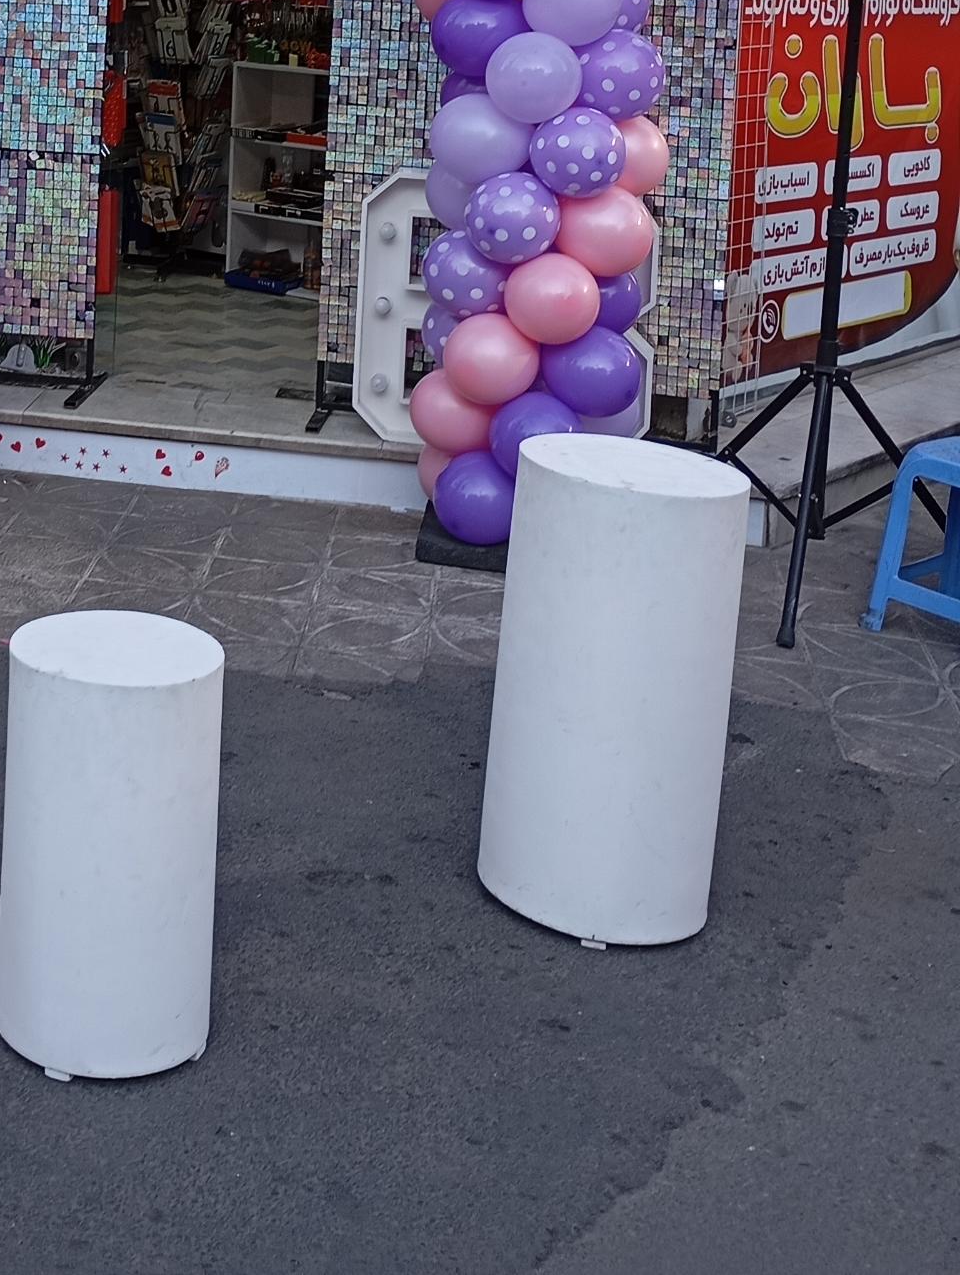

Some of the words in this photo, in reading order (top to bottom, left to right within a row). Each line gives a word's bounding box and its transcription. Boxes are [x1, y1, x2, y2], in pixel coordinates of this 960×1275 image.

[904, 155, 930, 178] کادویی
[780, 171, 810, 194] اسباب
[858, 207, 874, 227] عطر
[900, 200, 930, 219] عروسک
[764, 222, 786, 243] تولد
[786, 221, 798, 241] تم
[855, 247, 882, 268] مصرف
[907, 237, 929, 258] ظروف
[763, 263, 784, 286] بازی
[785, 255, 809, 282] آتش
[809, 256, 825, 278] ازم
